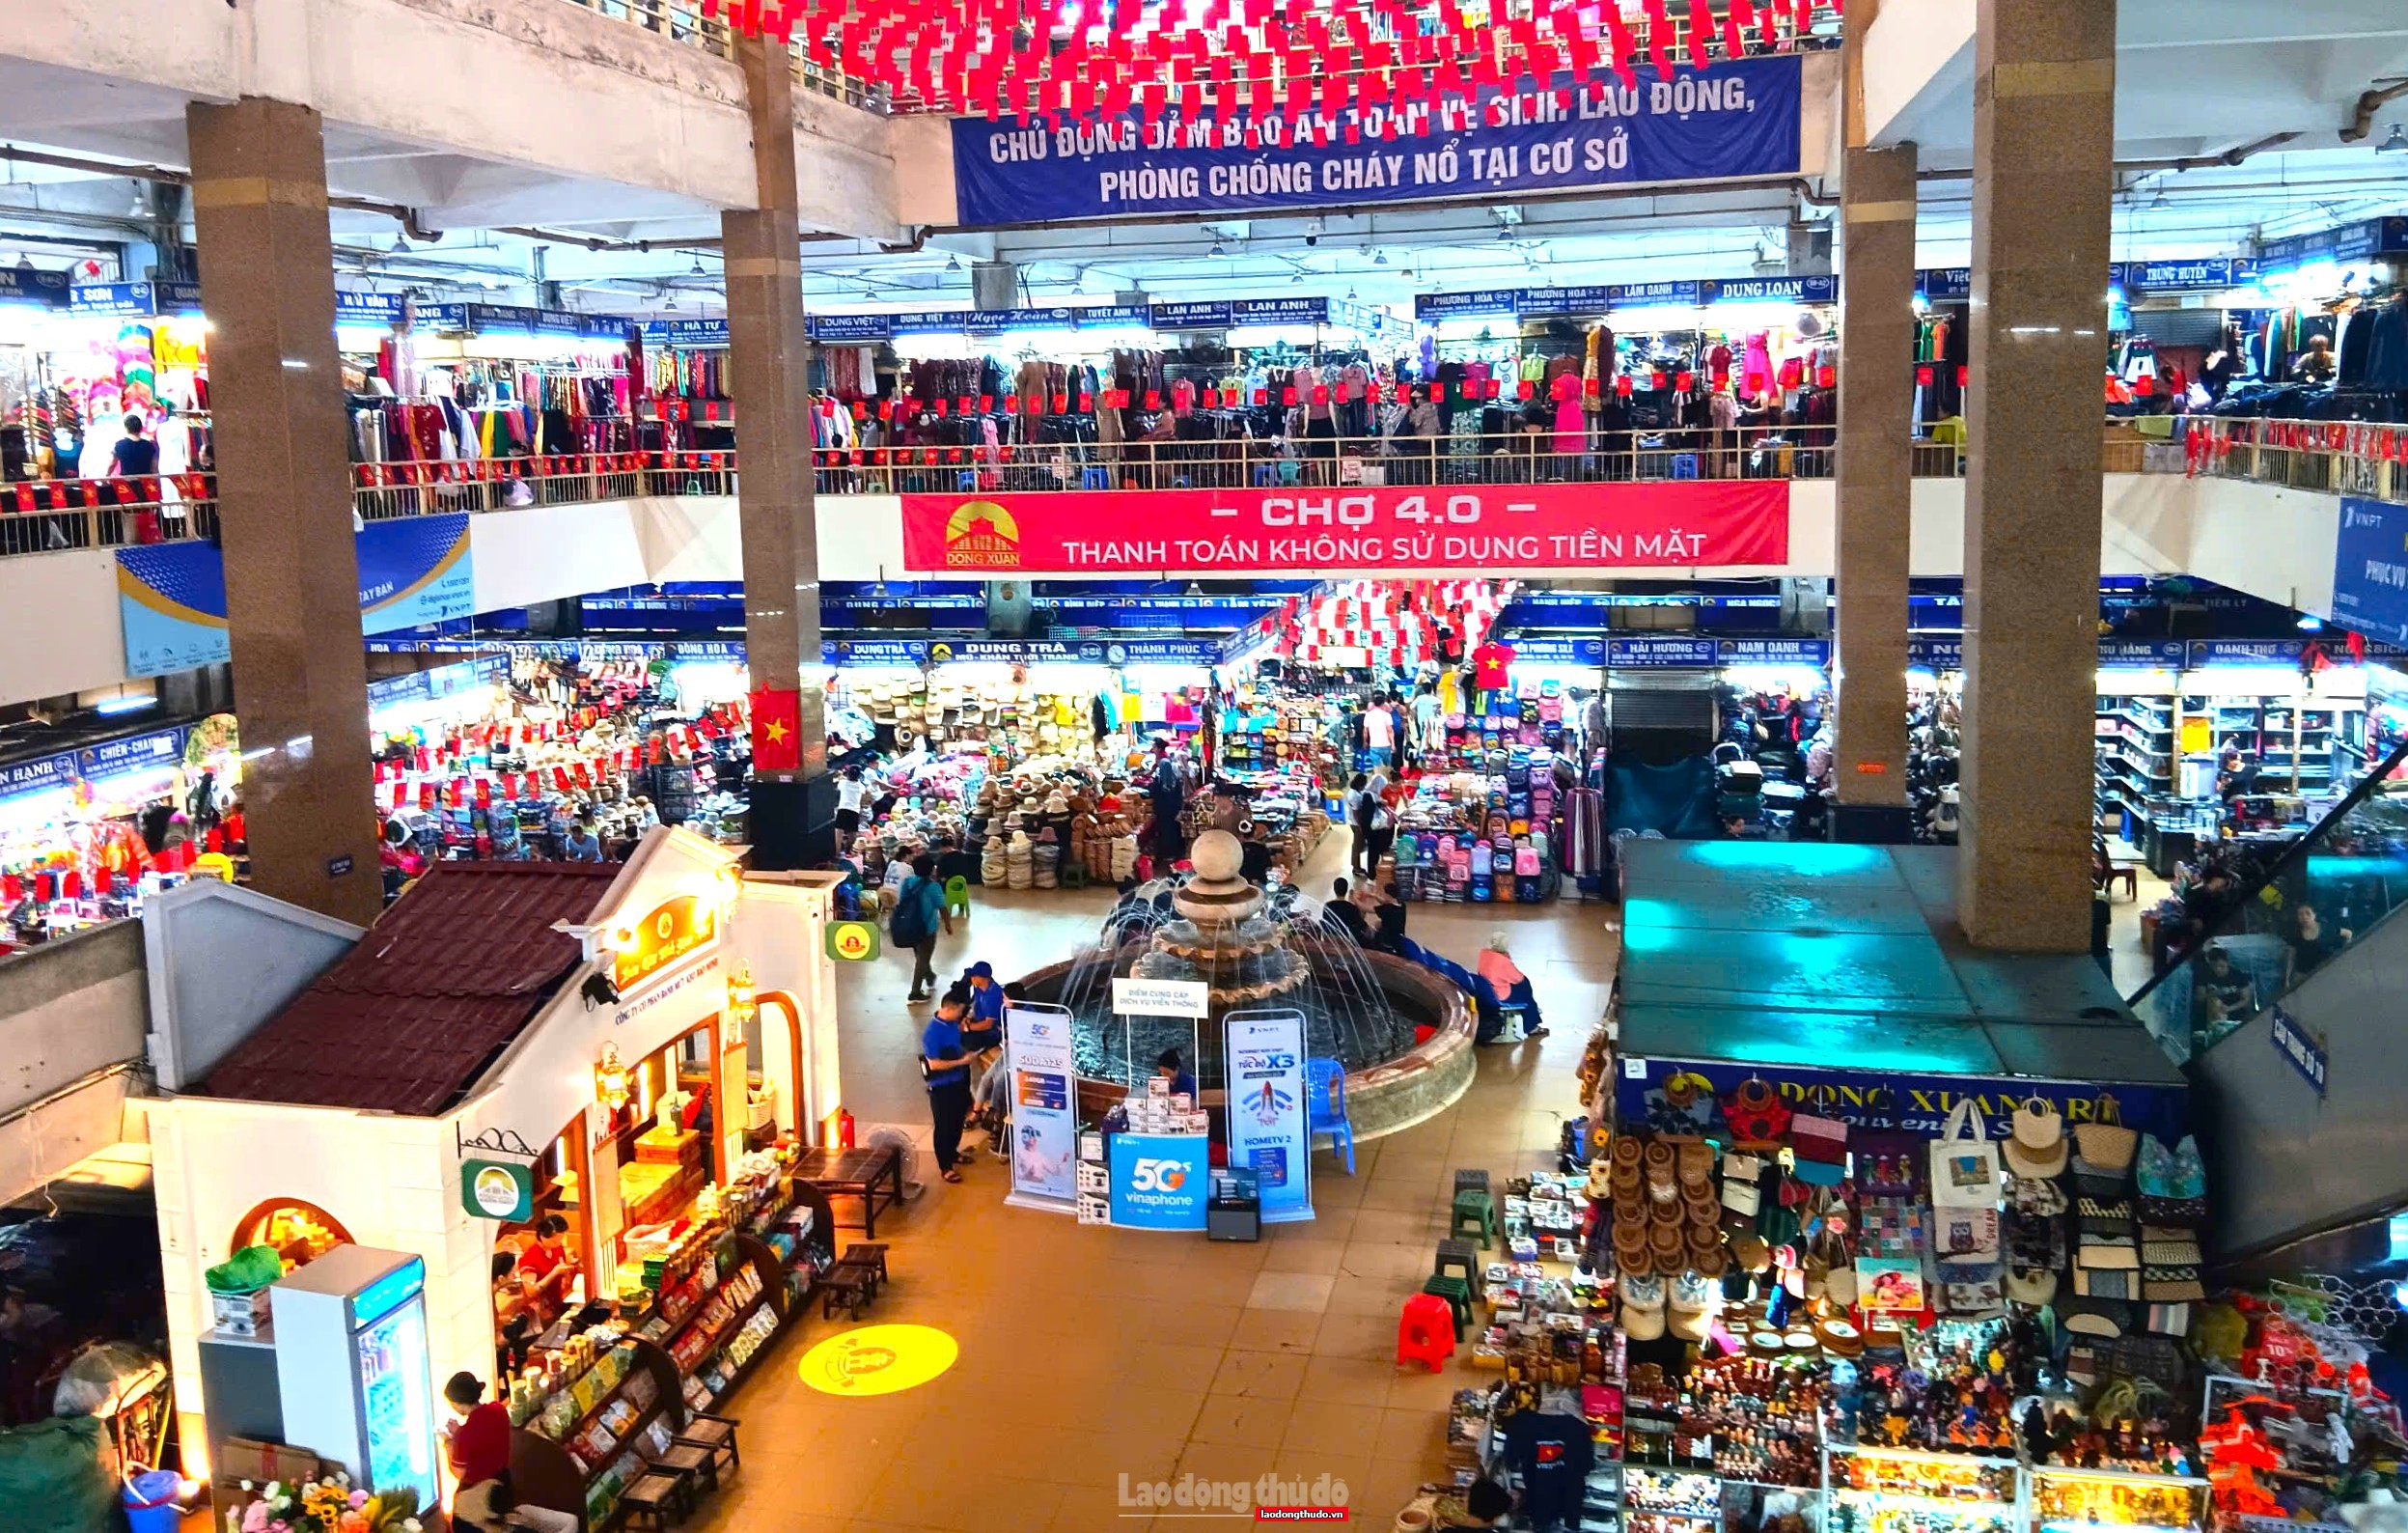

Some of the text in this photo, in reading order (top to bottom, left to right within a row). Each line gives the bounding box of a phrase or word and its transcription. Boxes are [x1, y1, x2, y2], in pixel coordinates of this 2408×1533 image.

[989, 119, 1047, 163] CHỦ
[1056, 119, 1137, 162] ĐỘNG
[1294, 113, 1337, 143] AN
[1485, 91, 1567, 127] SINH
[1579, 84, 1639, 120] LAO
[1649, 74, 1755, 121] ĐỘNG,
[1100, 126, 1628, 202] PHÒNG CHỐNG CHÁY NỔ TẠI CƠ SỞ
[1723, 281, 1803, 298] DUNG LOAN
[1167, 304, 1211, 315] LAN ANH
[1248, 300, 1309, 311] LAN ANH
[1114, 307, 1131, 317] ANH
[684, 320, 702, 330] HÀ
[825, 316, 874, 327] DUNG VIỆT
[900, 315, 923, 323] DUNG
[1260, 493, 1481, 531] CHỢ 4.0
[2355, 513, 2383, 528] VNPT
[1063, 527, 1706, 567] THANH TOÁN KHÔNG SỬ DỤNG TIỀN MẶT
[854, 644, 884, 655] DUNG
[965, 642, 1067, 654] DUNG TRÀ
[1128, 642, 1166, 654] THÀNH
[1652, 642, 1693, 653] HƯƠNG
[1738, 641, 1799, 653] NAM OANH
[1149, 989, 1172, 998] CUNG
[1172, 998, 1199, 1009] THÔNG
[1266, 1053, 1295, 1069] X3
[1131, 1157, 1187, 1192] 5G
[1125, 1191, 1194, 1206] vinaphone
